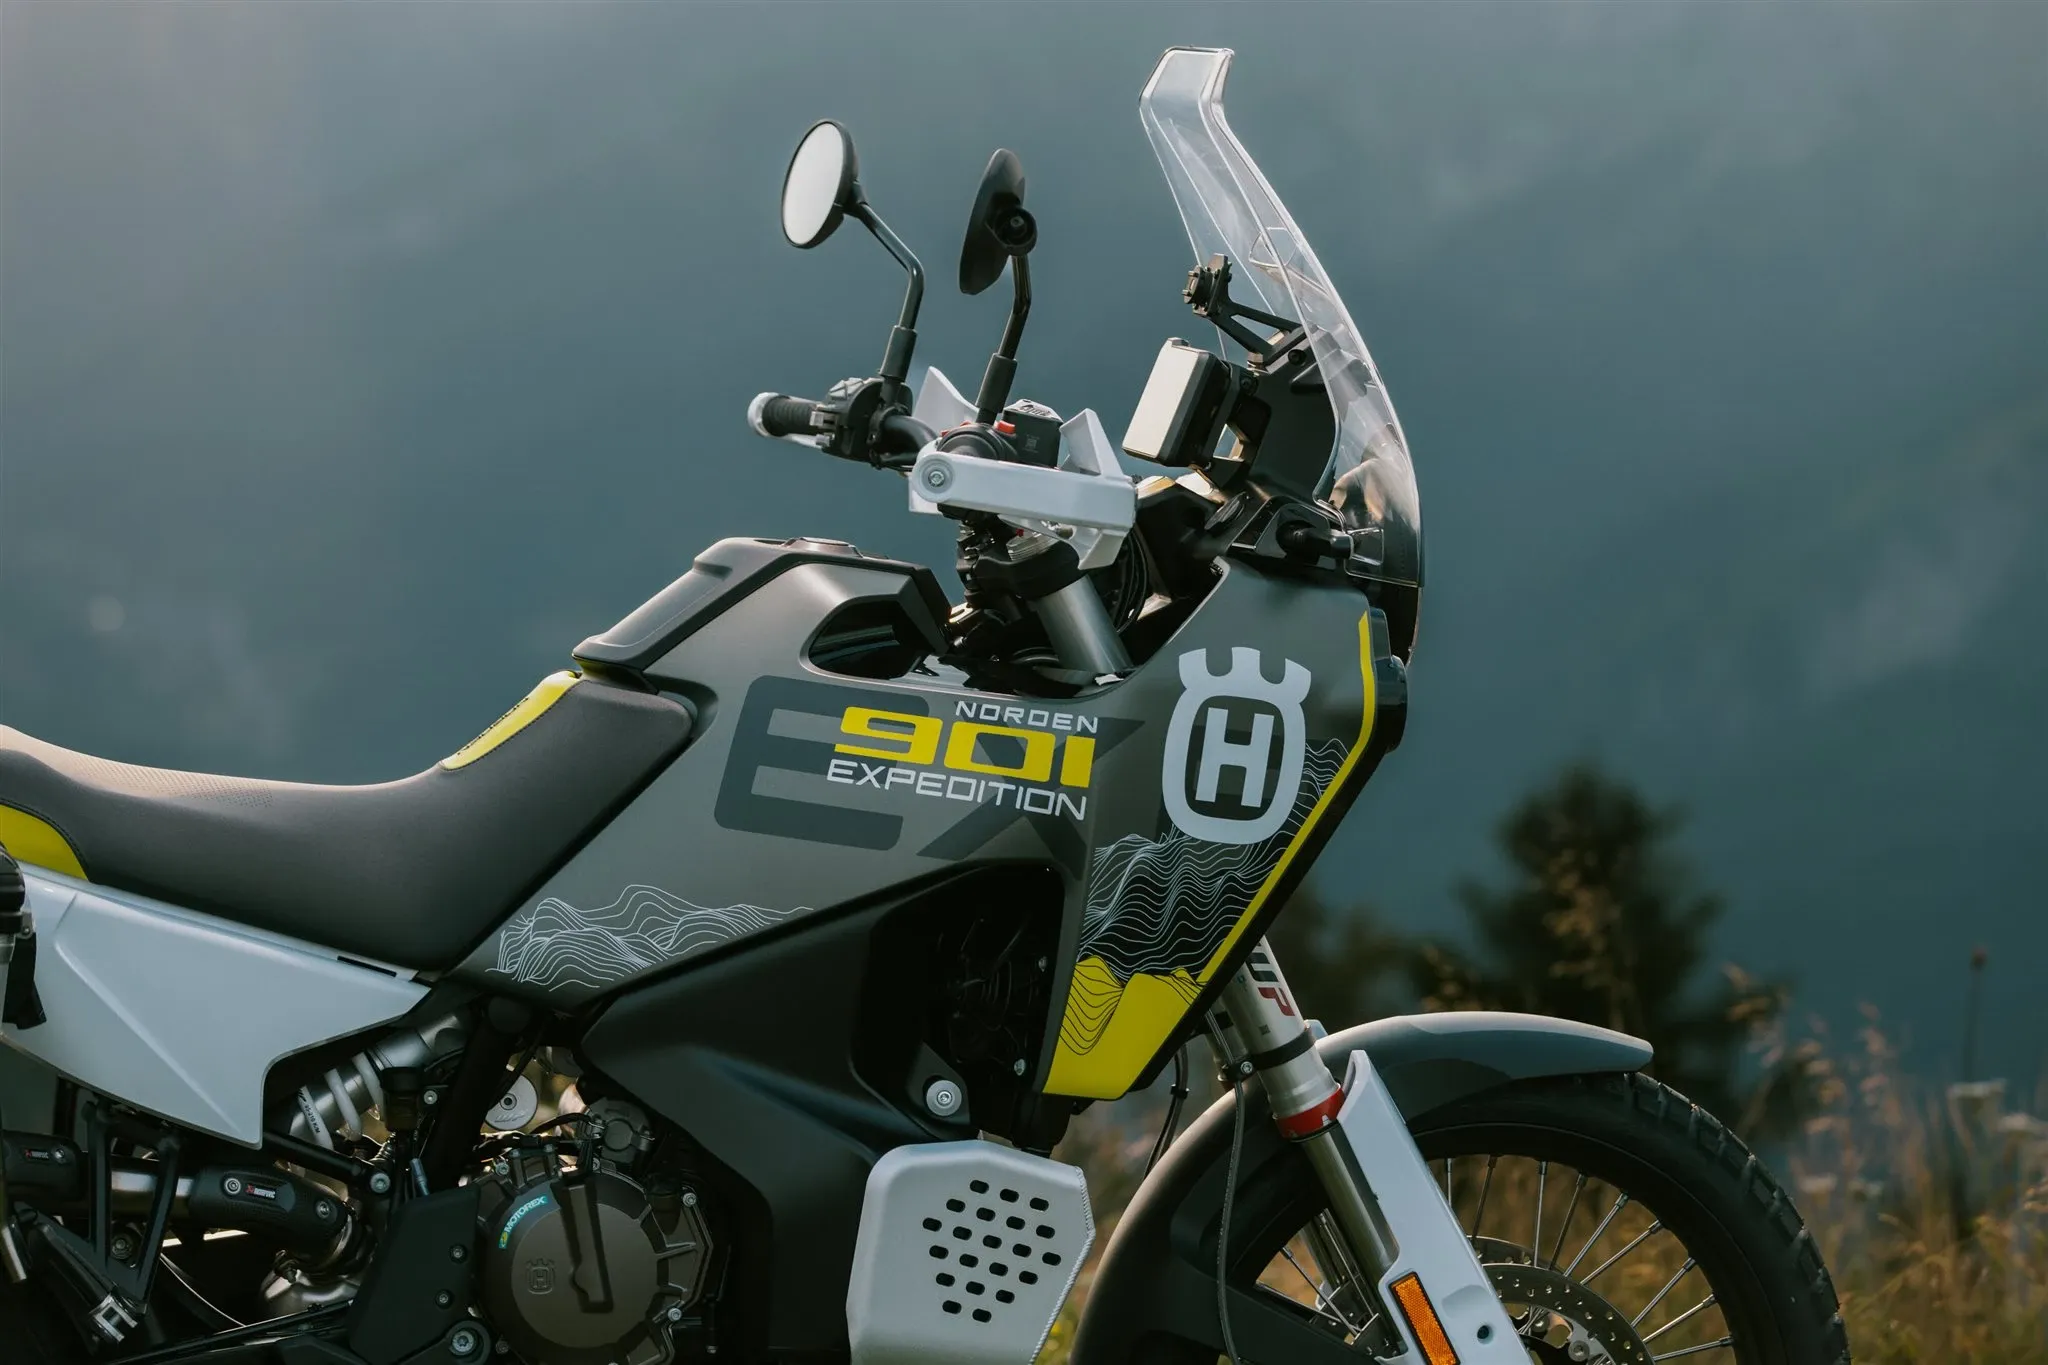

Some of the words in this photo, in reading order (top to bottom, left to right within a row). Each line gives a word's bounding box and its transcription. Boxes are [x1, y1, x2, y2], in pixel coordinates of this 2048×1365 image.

[955, 700, 1098, 734] NORDEN
[834, 706, 1096, 788] 901
[826, 758, 1087, 821] EXPEDITION
[503, 1195, 546, 1233] MOTOREX
